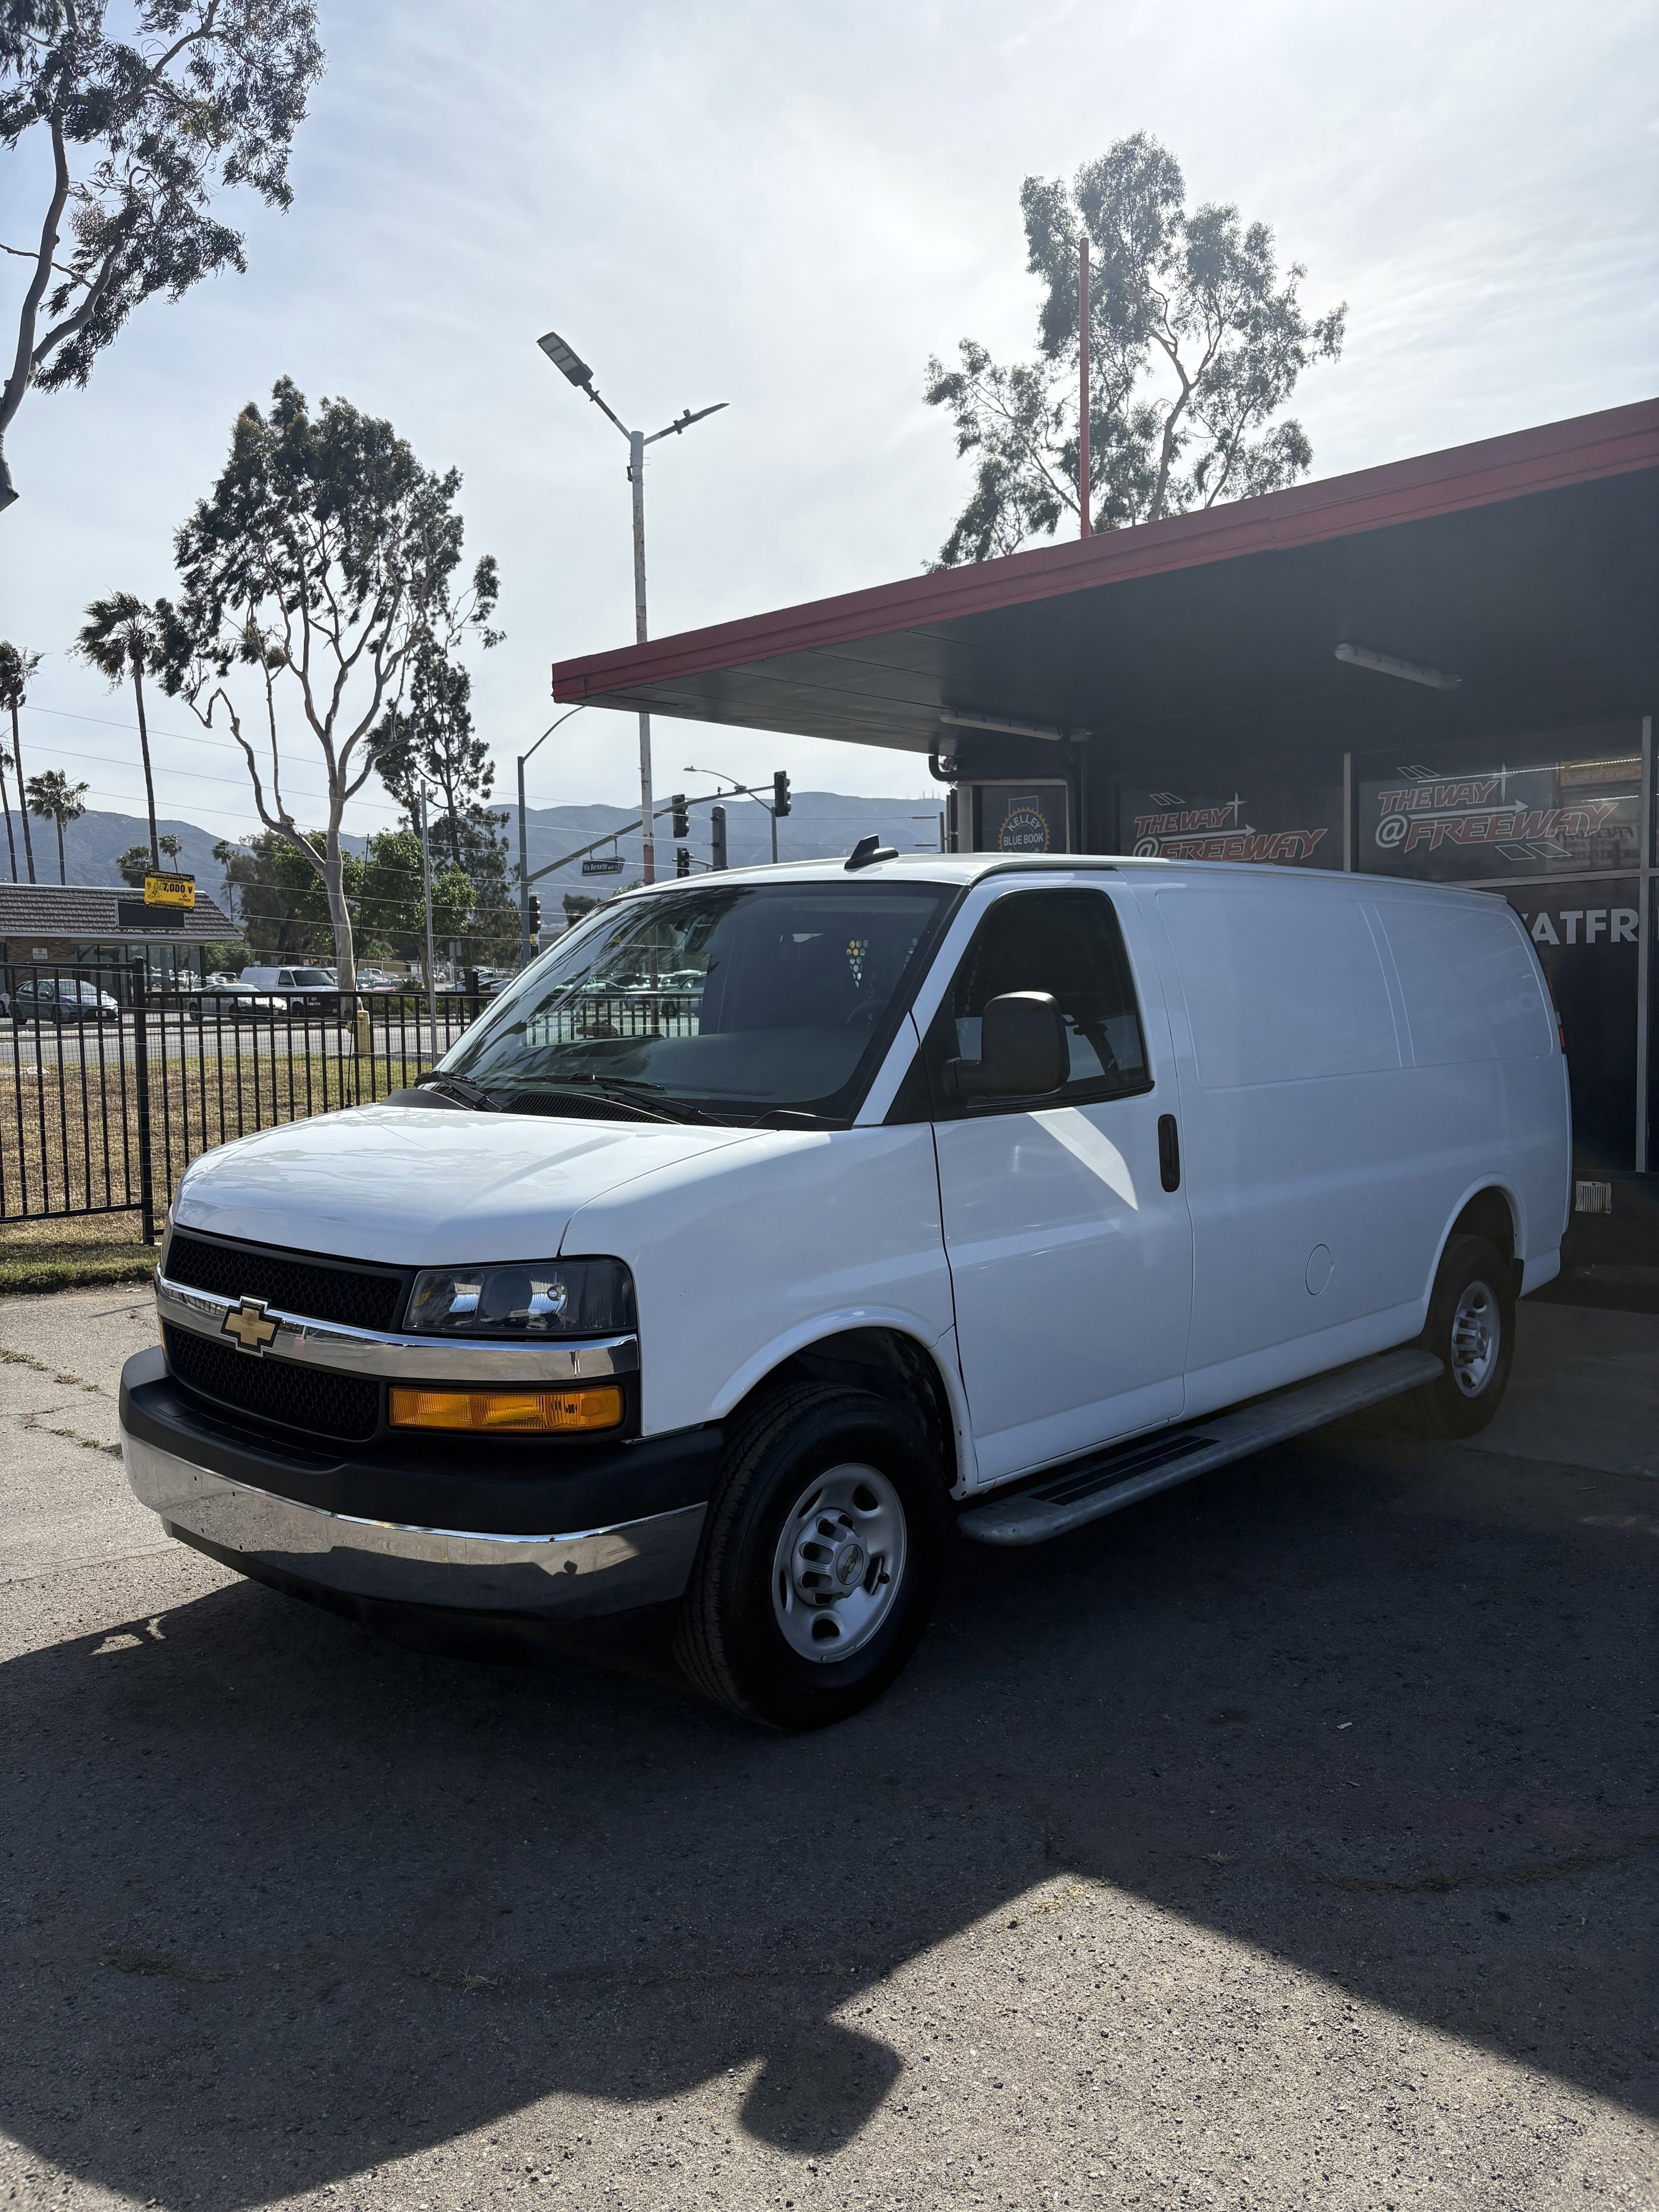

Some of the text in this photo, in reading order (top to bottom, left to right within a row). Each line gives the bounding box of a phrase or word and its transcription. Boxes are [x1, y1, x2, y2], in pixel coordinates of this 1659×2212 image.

[1378, 780, 1500, 815] THE WAY
[1007, 815, 1041, 832] KELLEY
[1134, 807, 1233, 838] THE WAY
[1375, 802, 1620, 853] @FREEWAY
[1004, 833, 1044, 846] BLUE BOOK
[163, 883, 185, 893] 7,000
[1521, 908, 1639, 945] ATFR
